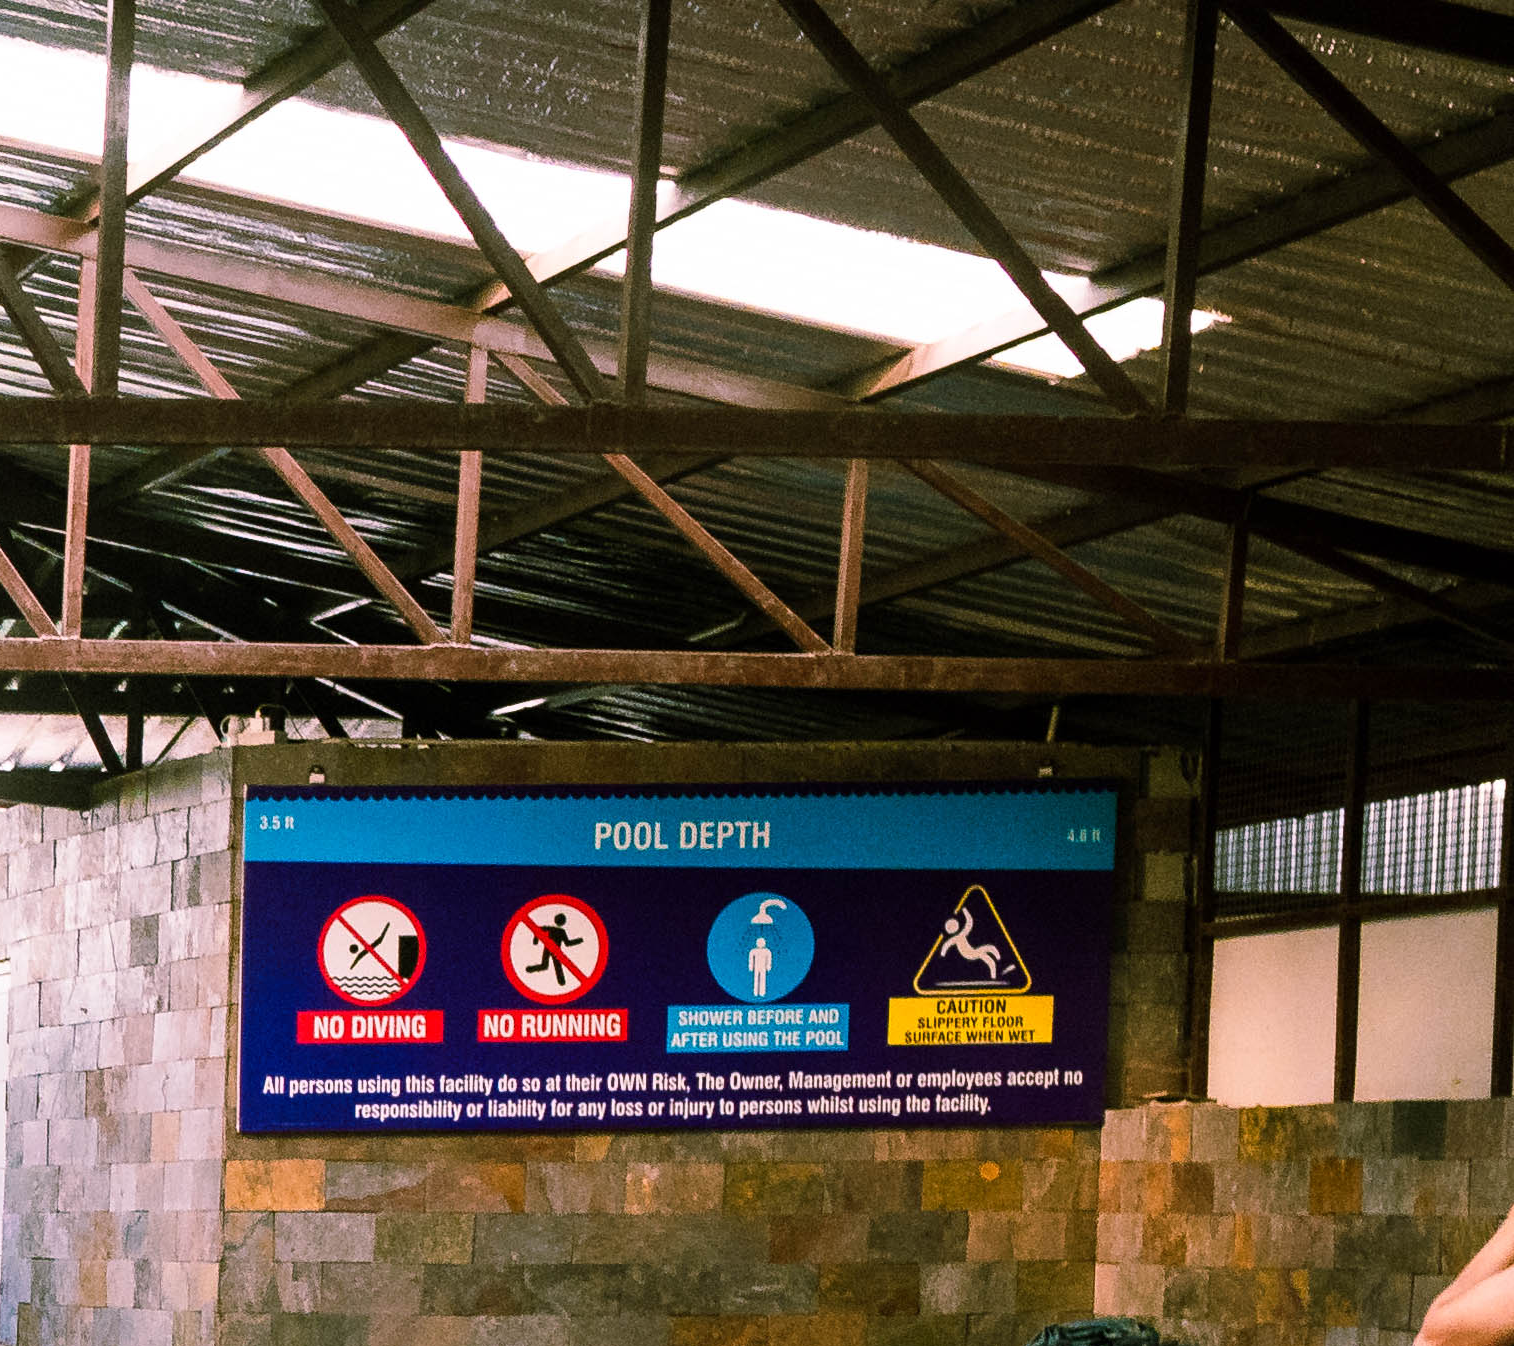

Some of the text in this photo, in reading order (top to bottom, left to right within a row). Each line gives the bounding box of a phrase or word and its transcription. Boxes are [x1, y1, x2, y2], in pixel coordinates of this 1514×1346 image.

[259, 814, 280, 830] 3.5
[594, 822, 770, 850] POOL DEPTH
[936, 999, 1006, 1014] CAUTION
[483, 1013, 621, 1038] NO RUNNING
[678, 1009, 839, 1026] SHOWER BEFORE AND
[918, 1016, 1023, 1029] SLIPPERY FLOOR
[313, 1015, 426, 1039] NO DIVING
[671, 1030, 844, 1048] AFTER USING THE POOL
[905, 1029, 1035, 1044] SURFACE WHEN WET
[263, 1068, 1083, 1098] All persons using this facility do so at their OWN Risk, The Owner, Management or employees accept no
[355, 1093, 991, 1122] responsibility or liability for any loss or injury to persons whilst using the facility.
